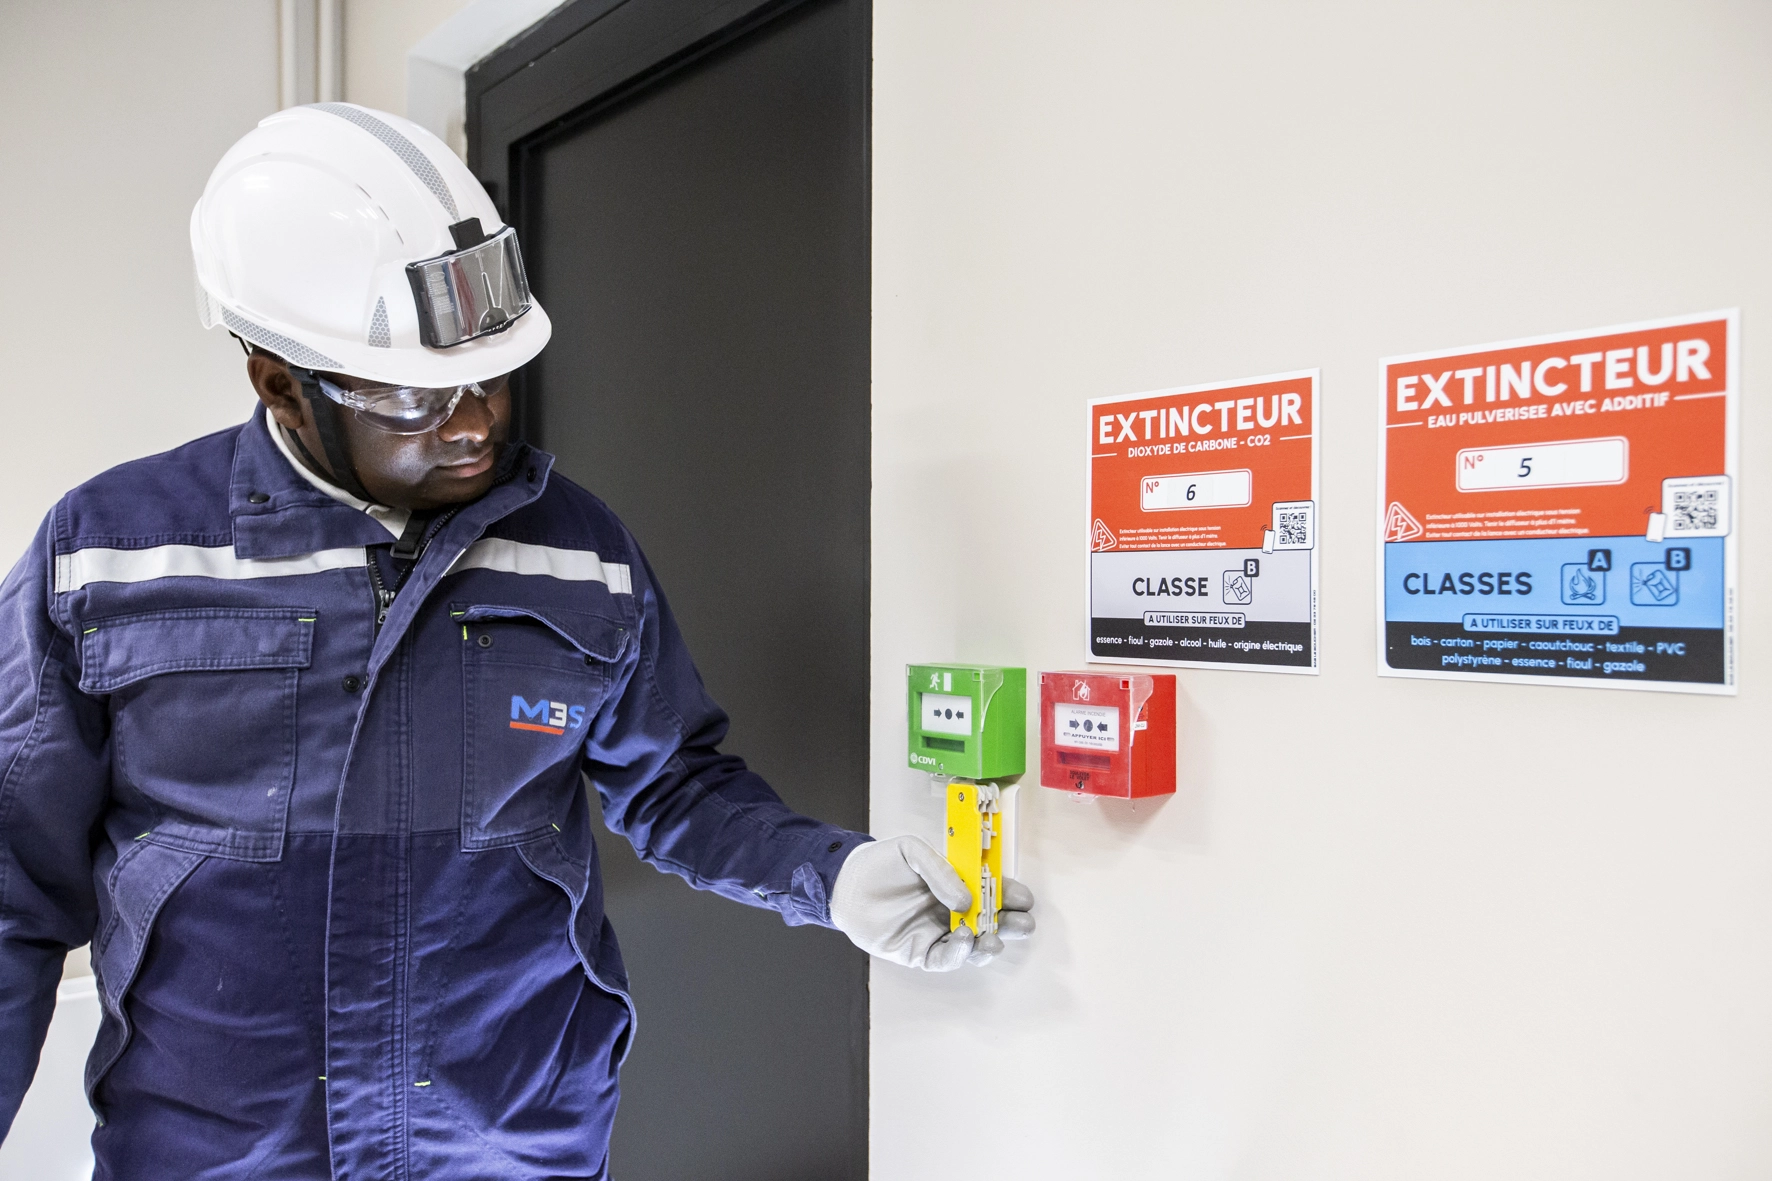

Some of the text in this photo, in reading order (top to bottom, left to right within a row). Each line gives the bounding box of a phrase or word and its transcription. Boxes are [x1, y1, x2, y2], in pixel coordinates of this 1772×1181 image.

[1396, 339, 1712, 411] EXTINCTEUR
[1100, 393, 1302, 444] EXTINCTEUR
[1428, 392, 1670, 428] EAU PULVERISEE AVEC ADDITIF
[1128, 445, 1170, 458] DIOXYDE
[1174, 443, 1186, 453] DE
[1188, 438, 1237, 452] CARBONE
[1247, 435, 1270, 446] CO2
[1518, 458, 1532, 477] 5
[1186, 484, 1196, 500] 6
[1247, 561, 1256, 575] B
[1591, 552, 1608, 569] A
[1670, 550, 1684, 567] B
[1132, 577, 1208, 596] CLASSE
[1403, 572, 1532, 595] CLASSES
[1156, 615, 1189, 624] UTILISER
[1191, 616, 1206, 624] SUR
[1209, 616, 1229, 625] FEUX
[1232, 617, 1242, 625] DE
[1470, 619, 1613, 631] A UTILISER SUR FEUX DE
[1096, 636, 1122, 644] essence
[1128, 636, 1143, 645] fioul
[1149, 637, 1173, 647] gazole
[1180, 638, 1201, 647] alcool
[1209, 639, 1226, 648] huile
[1234, 640, 1260, 651] origine
[1262, 640, 1303, 653] électrique
[1411, 635, 1431, 646] bois
[1440, 638, 1473, 647] carton
[1483, 638, 1518, 651] papier
[1529, 640, 1594, 651] caoutchouc
[1606, 642, 1644, 654] textile
[1657, 642, 1685, 655] PVC
[1442, 654, 1500, 667] polystyrène
[1512, 658, 1555, 668] essence
[1567, 657, 1591, 669] fioul
[1603, 660, 1645, 674] gazole
[510, 696, 585, 729] M3S
[918, 756, 936, 765] CDVI
